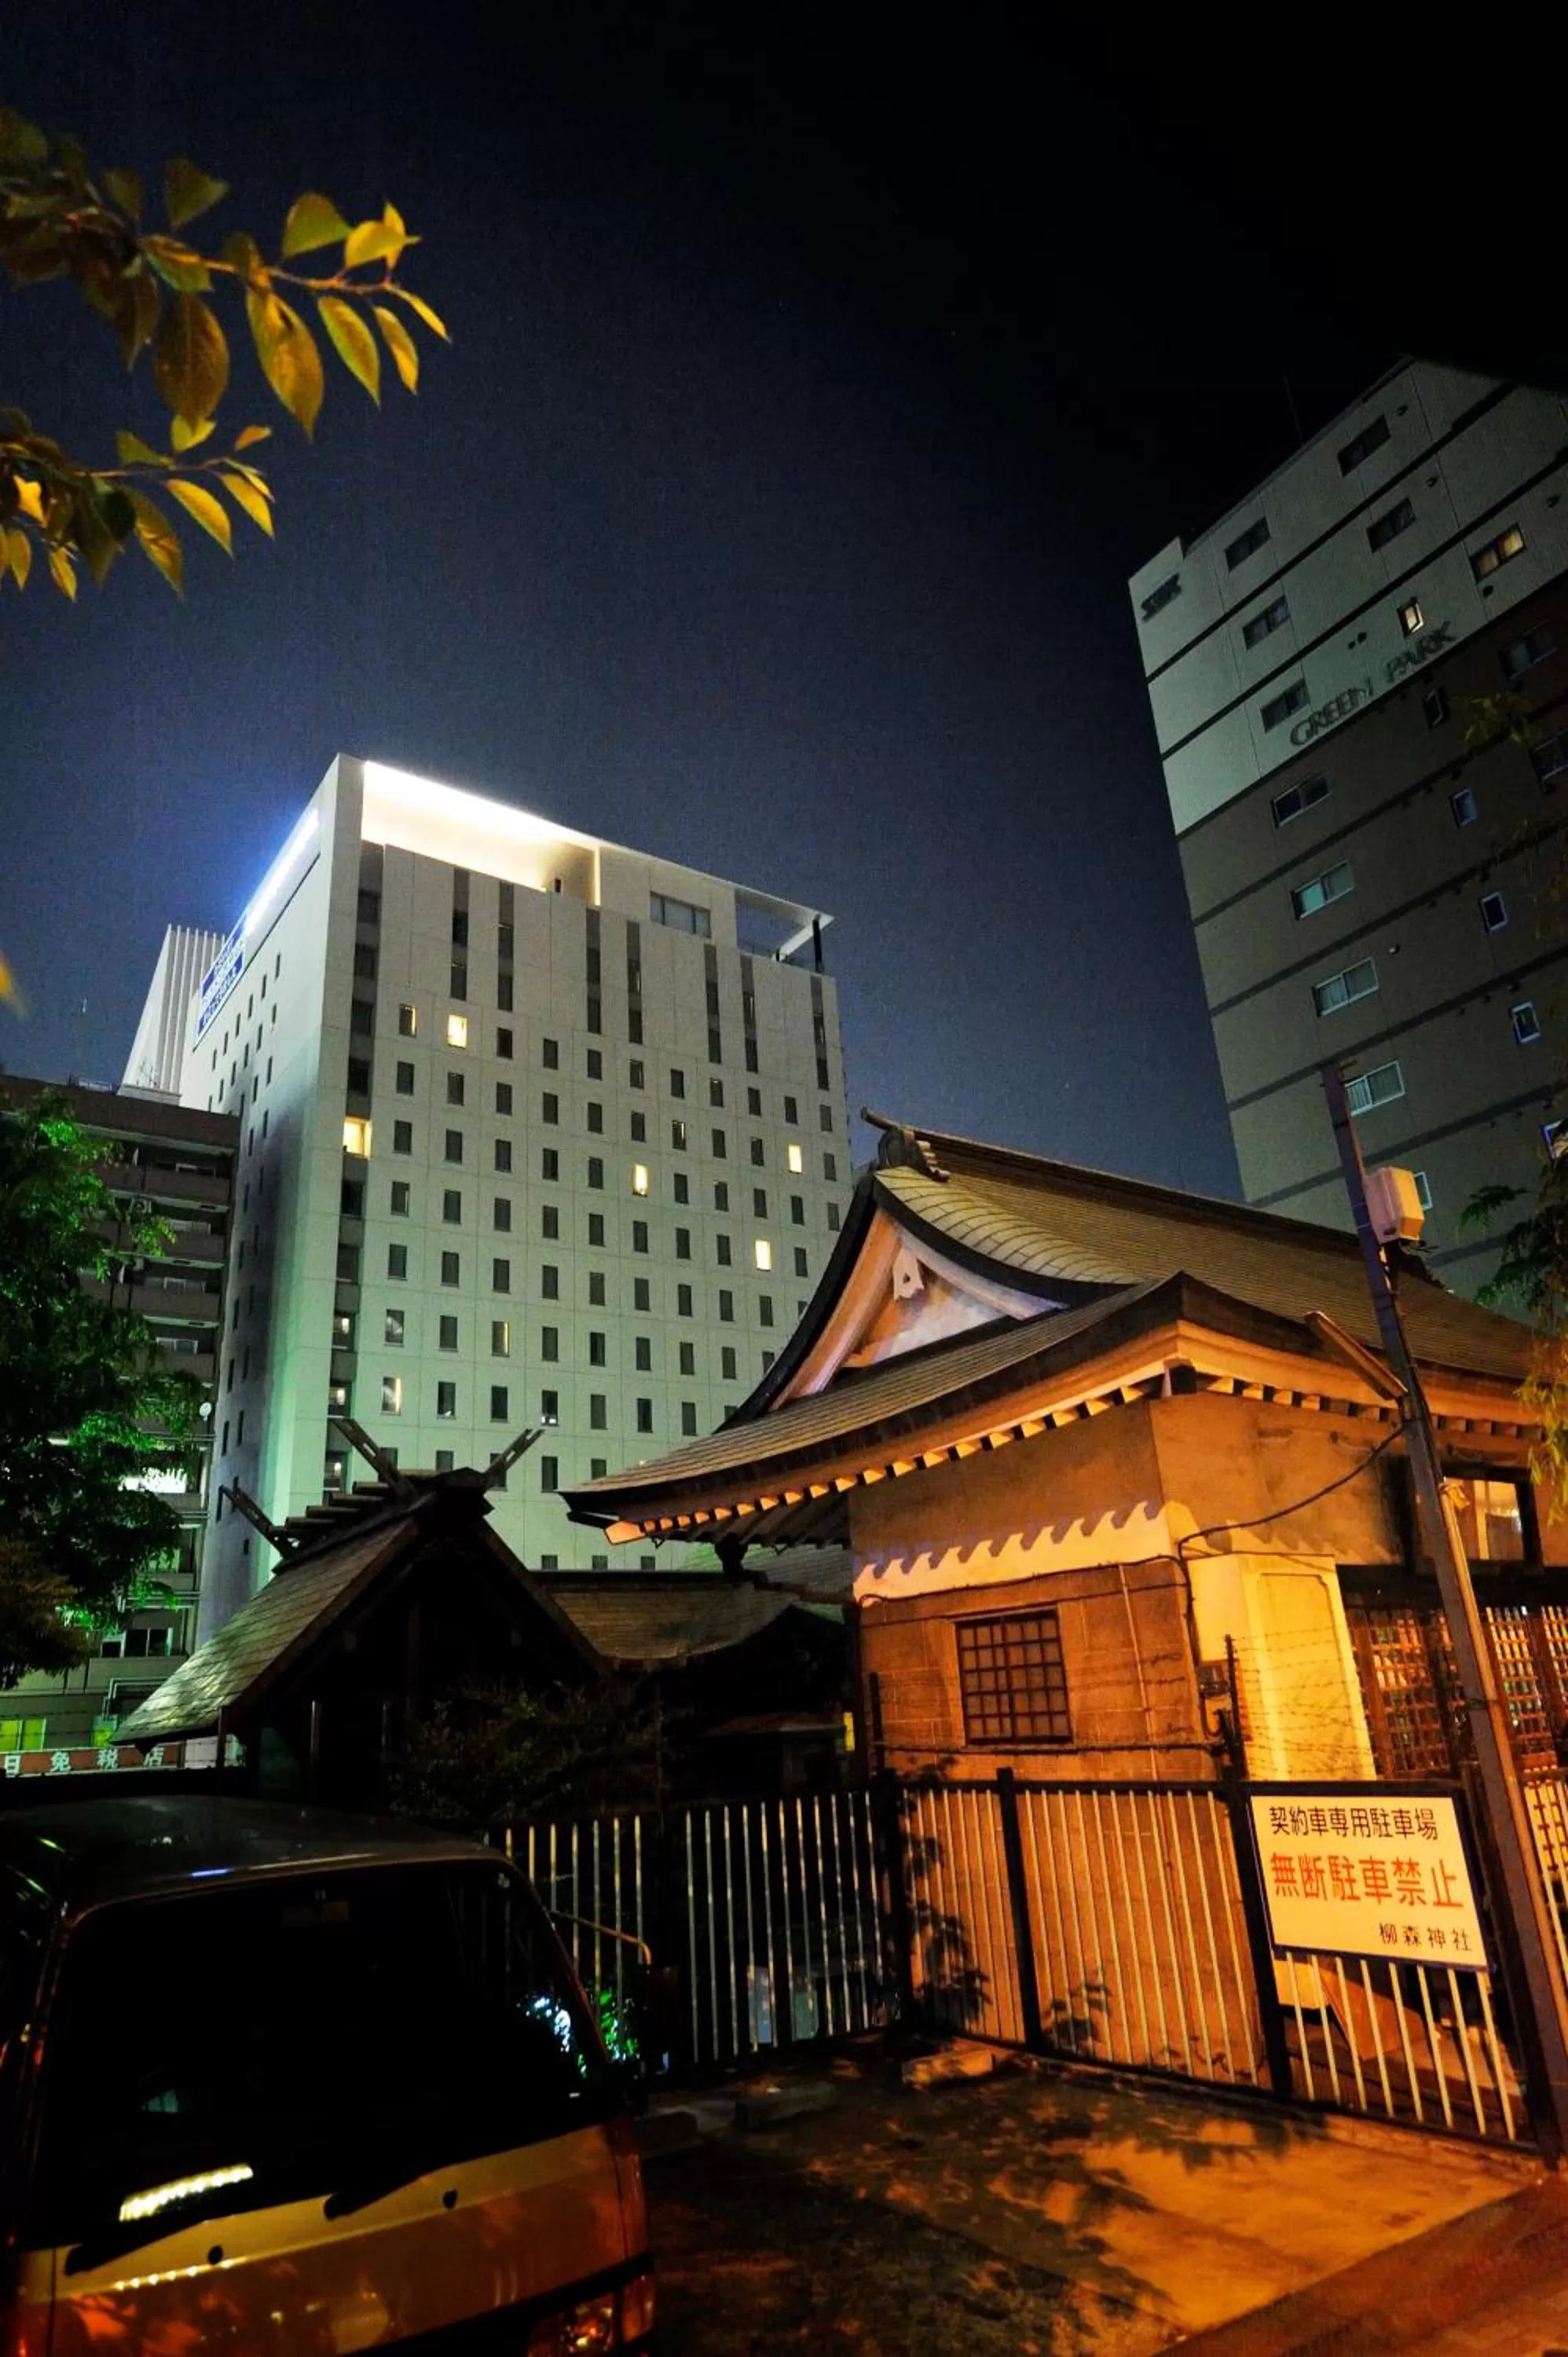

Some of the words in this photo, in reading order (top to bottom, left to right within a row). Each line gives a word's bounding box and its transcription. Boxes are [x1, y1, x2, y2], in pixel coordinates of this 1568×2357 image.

[1290, 676, 1374, 746] GREEN
[1383, 621, 1454, 684] PARK
[1269, 1806, 1438, 1841] 契約車専用駐車場
[1269, 1852, 1464, 1908] 無断駐車禁止
